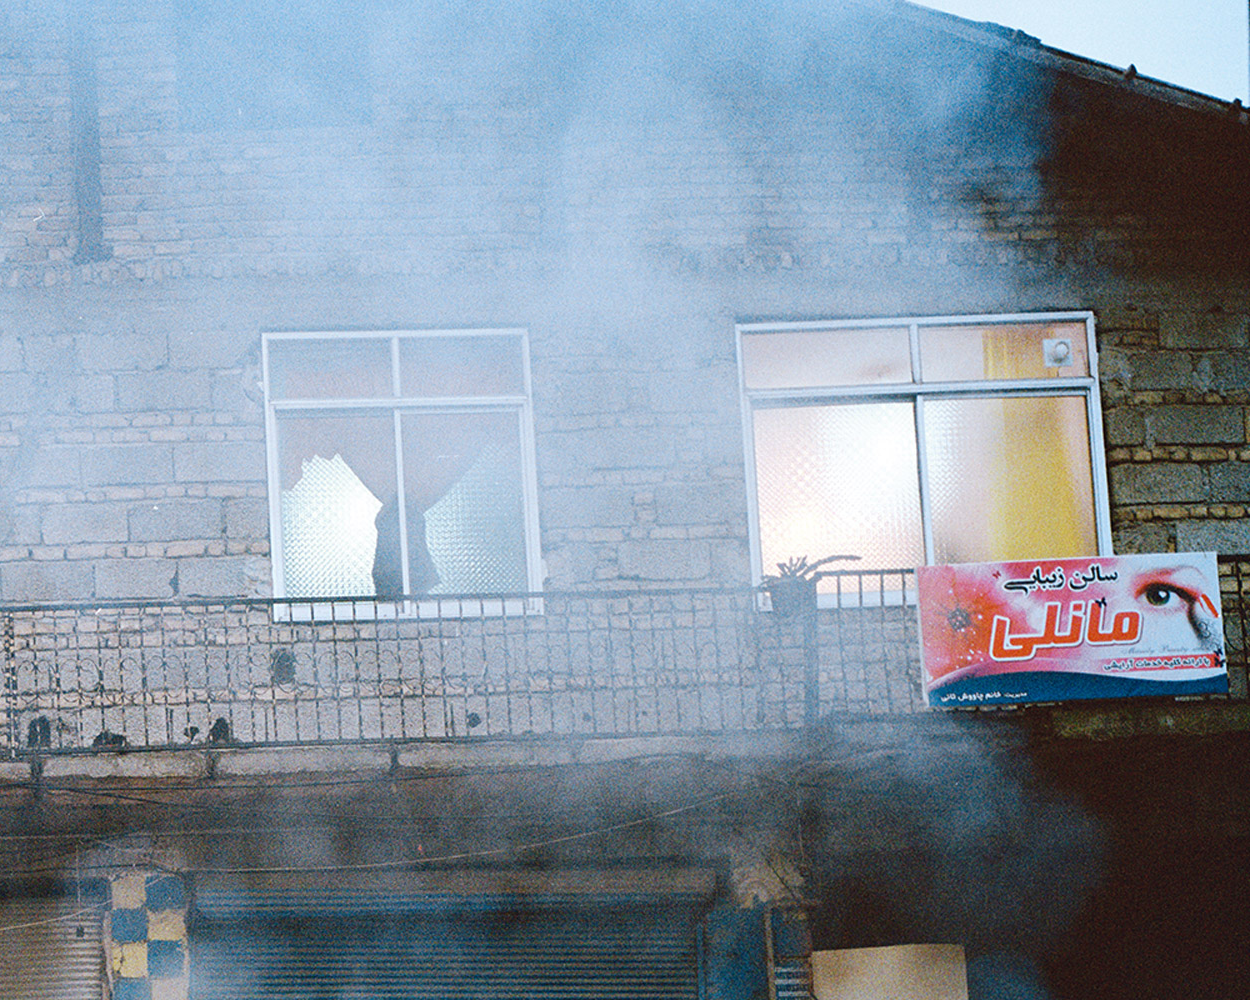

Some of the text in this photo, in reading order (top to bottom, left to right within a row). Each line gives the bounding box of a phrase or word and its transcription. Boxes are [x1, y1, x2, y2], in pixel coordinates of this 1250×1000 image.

[1004, 563, 1118, 595] سالن زیبایی
[991, 600, 1143, 661] مانلی
[1103, 659, 1133, 671] آرایشی
[1134, 658, 1162, 668] خدمات
[1164, 657, 1181, 669] کلیه
[1203, 656, 1211, 667] با
[985, 691, 1001, 701] خانم
